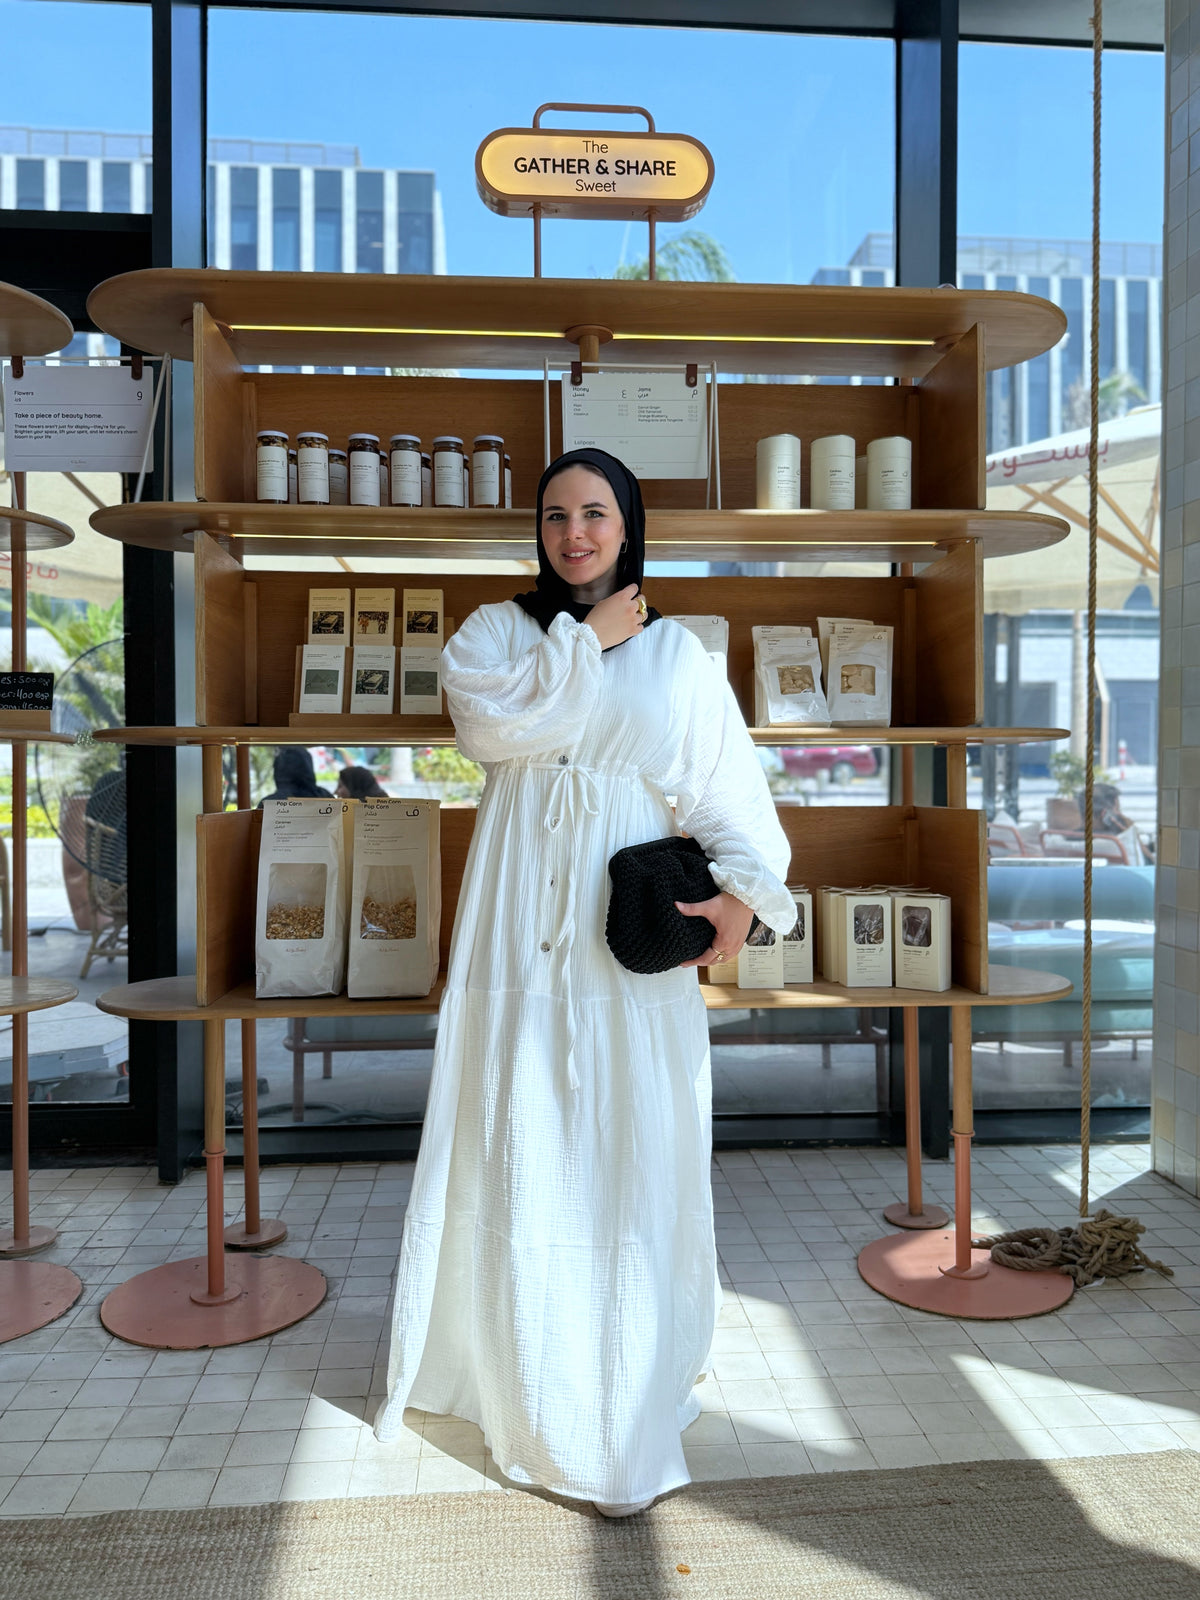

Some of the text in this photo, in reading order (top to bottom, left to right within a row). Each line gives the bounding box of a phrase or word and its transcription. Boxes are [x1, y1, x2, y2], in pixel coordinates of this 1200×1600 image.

[582, 140, 609, 154] The
[514, 157, 677, 176] GATHER & SHARE
[575, 178, 617, 193] Sweet
[36, 412, 52, 420] piece
[61, 412, 84, 420] beauty
[318, 803, 333, 815] ف
[405, 806, 420, 817] ف
